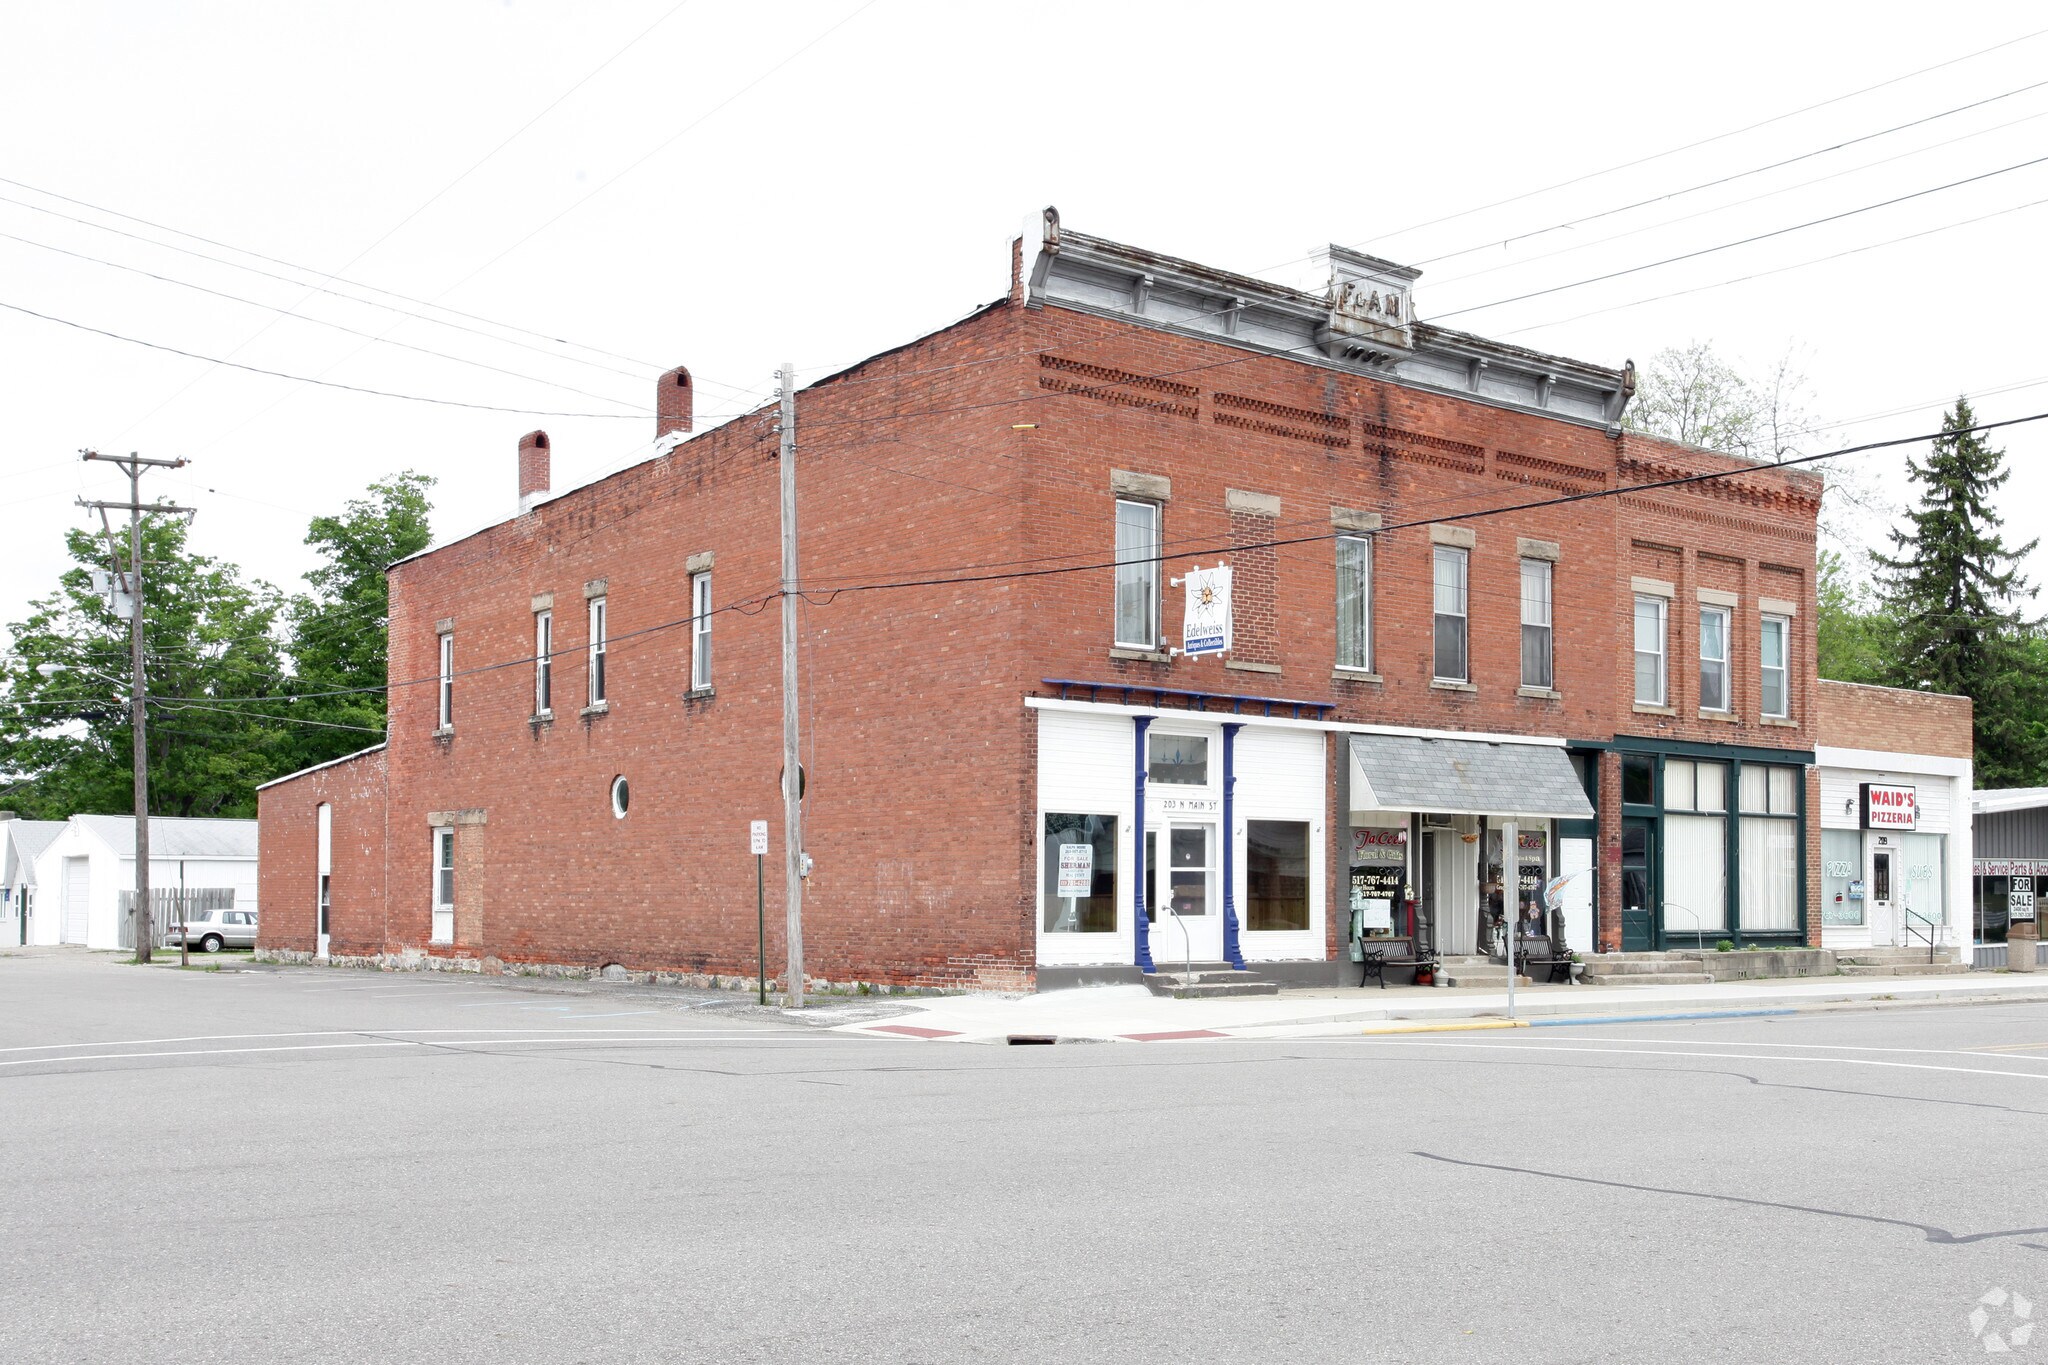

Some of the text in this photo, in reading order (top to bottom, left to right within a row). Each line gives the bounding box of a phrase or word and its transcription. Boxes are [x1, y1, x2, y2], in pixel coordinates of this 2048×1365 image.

[1186, 620, 1223, 638] Edelweiss
[1187, 640, 1200, 651] Antiques
[1204, 637, 1223, 647] Collectibles
[1163, 800, 1217, 810] 203 N MAIN ST
[1870, 790, 1914, 807] WAID'S
[1871, 811, 1913, 824] PIZZERIA
[1878, 836, 1888, 845] 209
[1357, 849, 1404, 860] Floral & Gifts
[1826, 860, 1852, 878] PIZZA
[1911, 864, 1933, 879] SUBS
[1983, 861, 1987, 875] &
[1988, 861, 2008, 875] Service
[2010, 861, 2027, 875] Parts
[2029, 861, 2033, 875] &
[1352, 875, 1399, 885] 517-767-4414
[2012, 878, 2030, 890] FOR
[2010, 895, 2032, 906] SALE
